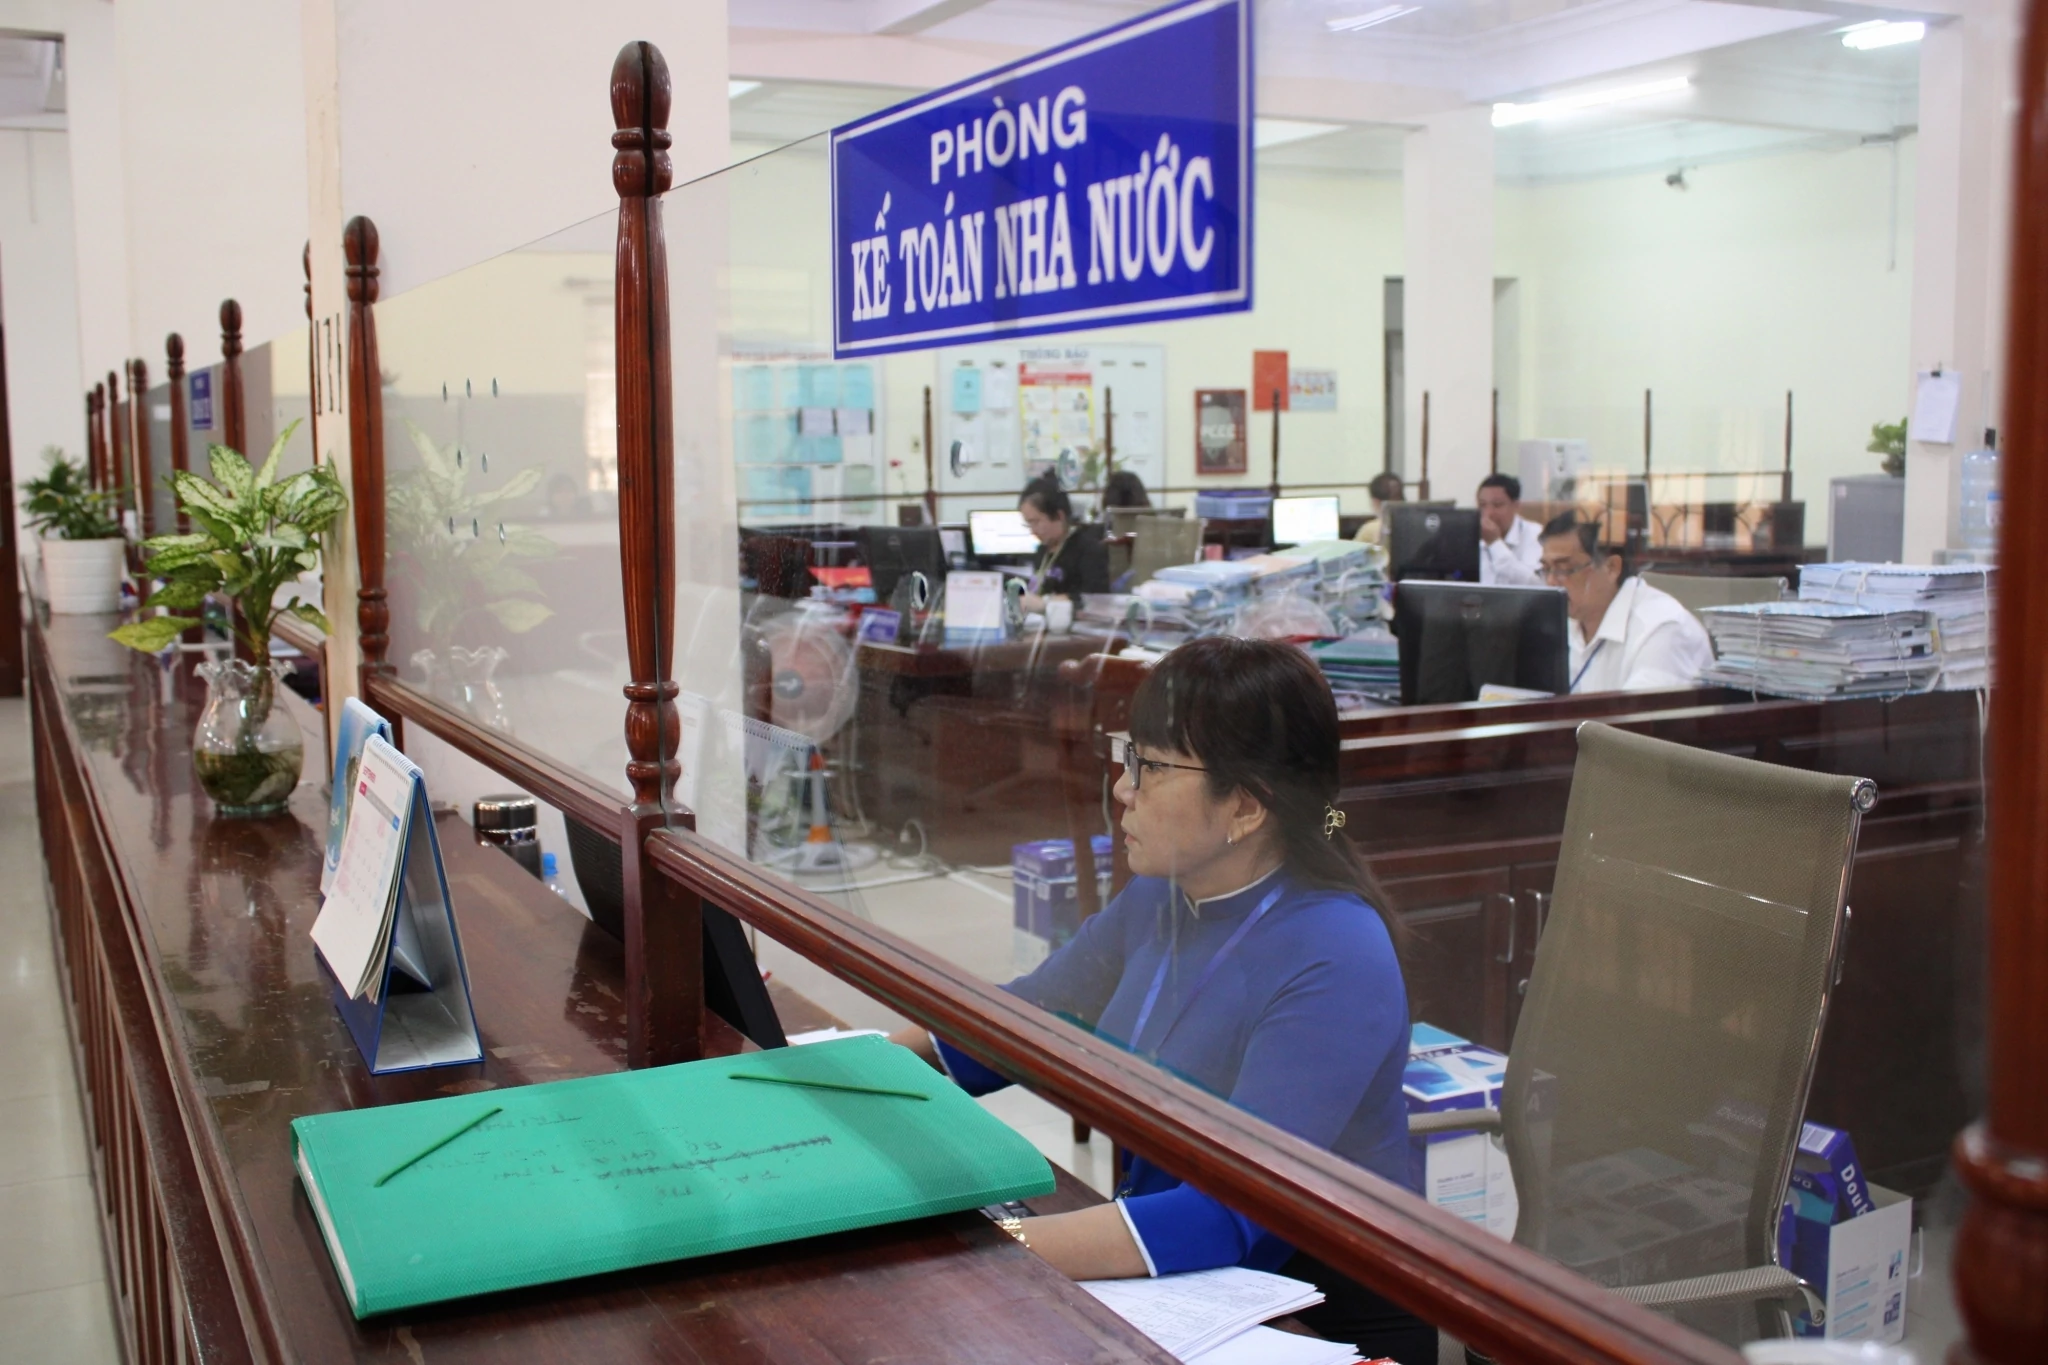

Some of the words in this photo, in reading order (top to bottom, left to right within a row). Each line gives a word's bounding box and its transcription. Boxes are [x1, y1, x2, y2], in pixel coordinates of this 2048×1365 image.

[930, 86, 1087, 184] PHÒNG
[851, 191, 891, 322] KẾ
[900, 191, 985, 314] TOÁN
[994, 162, 1077, 299] NHÀ
[1087, 133, 1215, 285] NƯỚC
